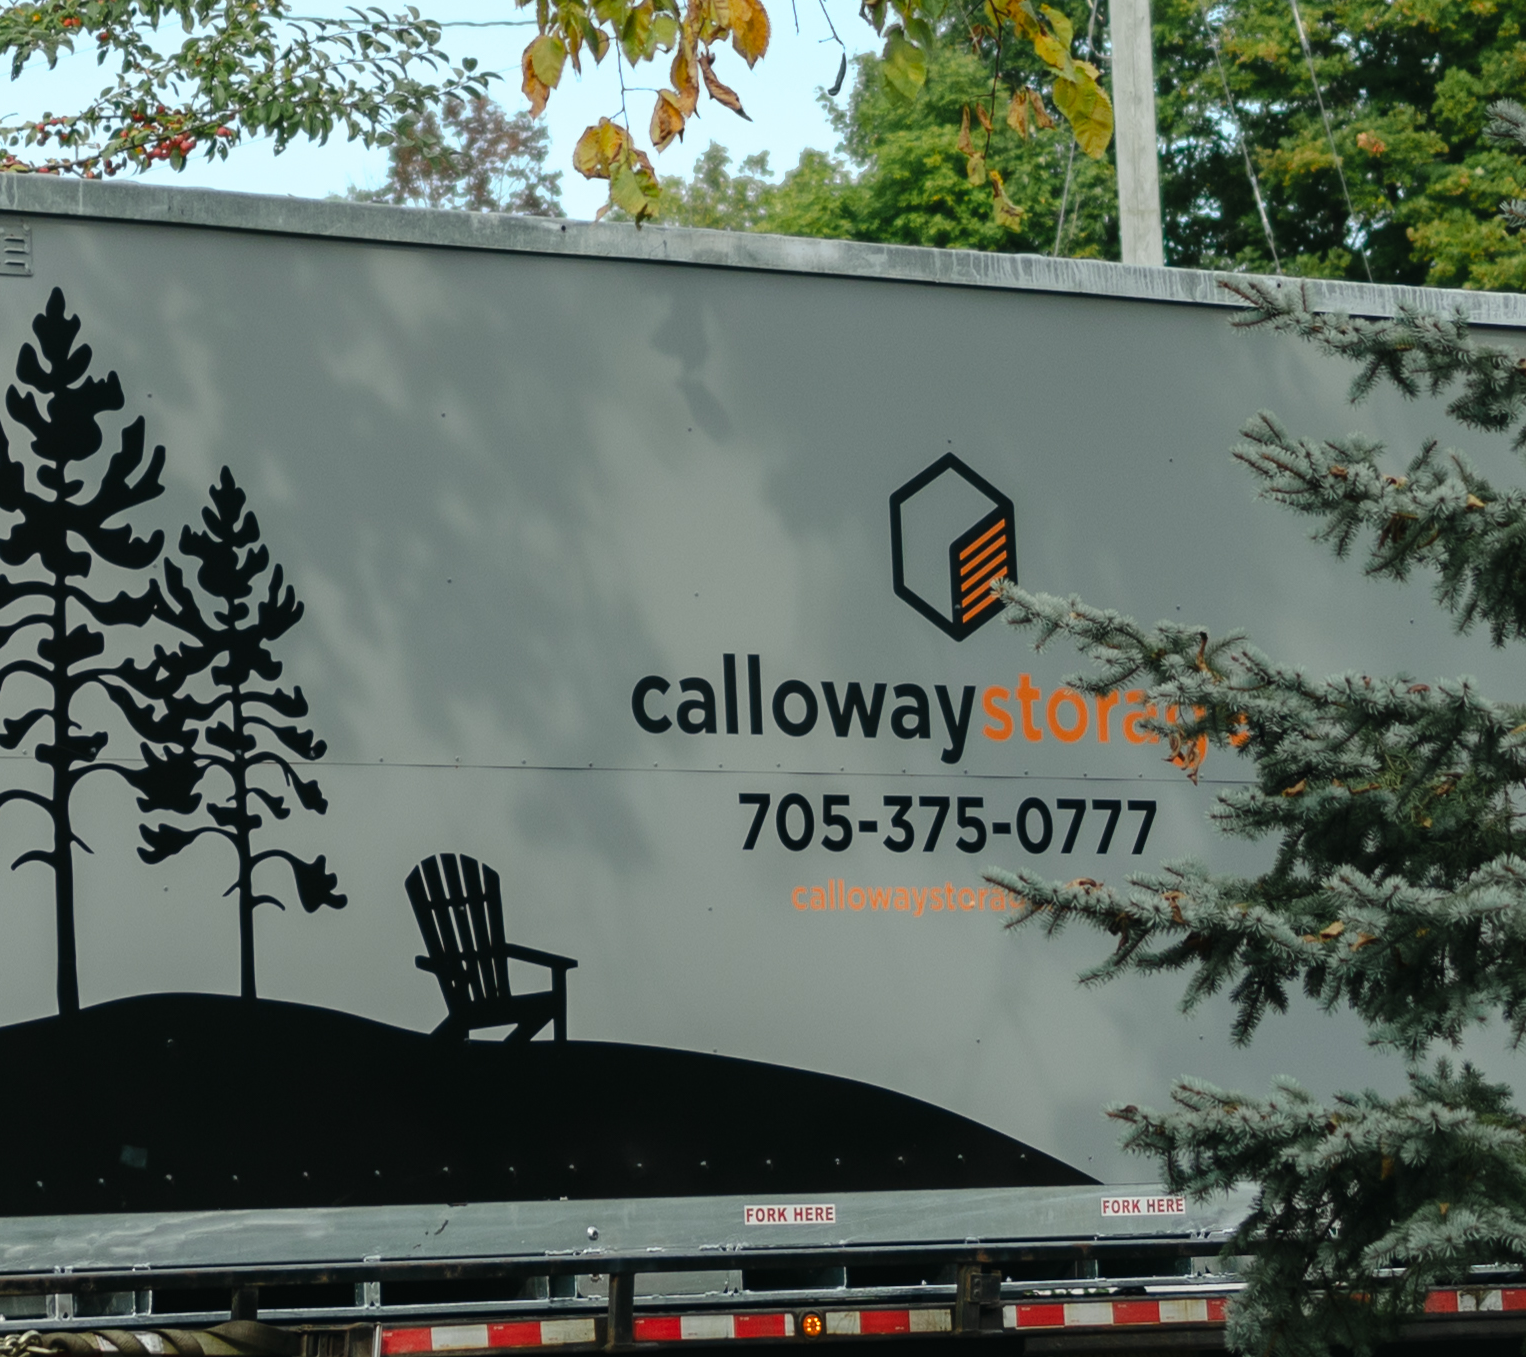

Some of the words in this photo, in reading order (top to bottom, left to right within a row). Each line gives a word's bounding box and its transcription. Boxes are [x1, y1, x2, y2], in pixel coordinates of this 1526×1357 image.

[630, 652, 1251, 767] callowaystorag
[738, 792, 1158, 856] 705-375-0777
[746, 1207, 788, 1224] FORK
[794, 1206, 835, 1223] HERE
[1102, 1198, 1140, 1215] FORK
[1146, 1198, 1184, 1214] HERE
